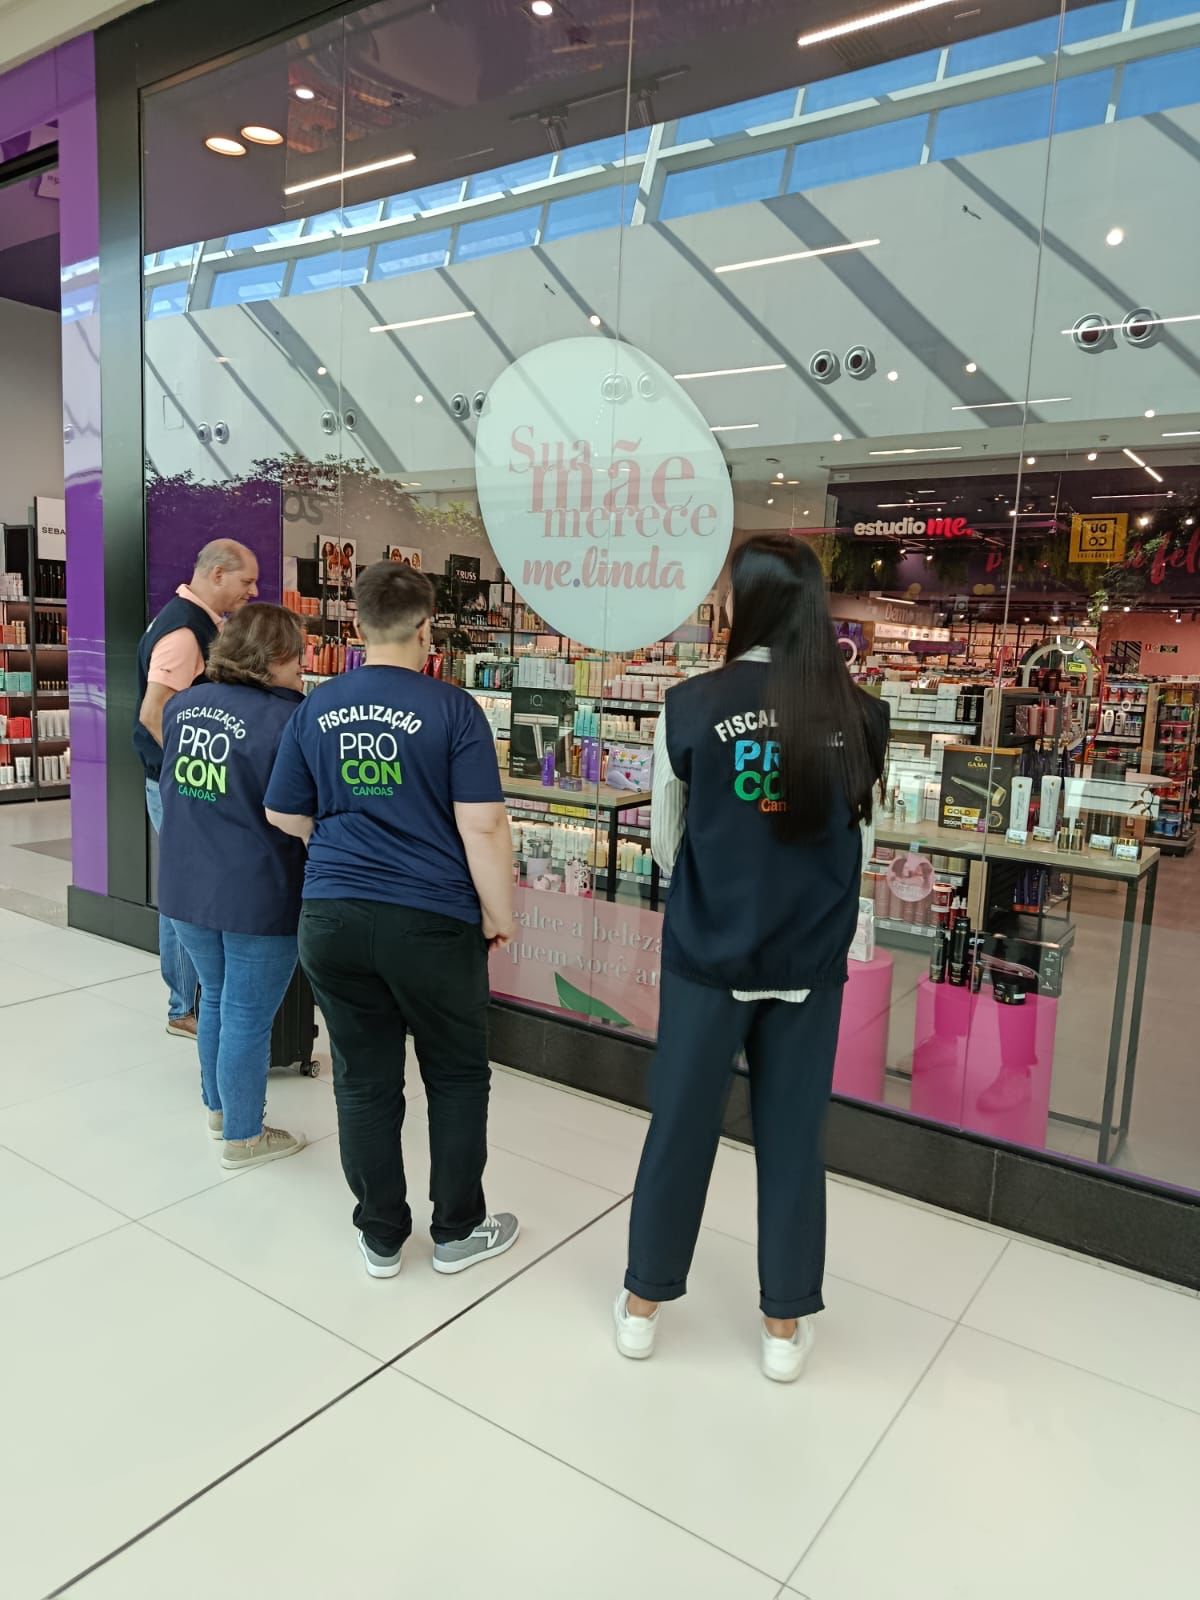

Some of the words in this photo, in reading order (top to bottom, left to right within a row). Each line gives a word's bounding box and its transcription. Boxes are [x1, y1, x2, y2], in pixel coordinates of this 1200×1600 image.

[509, 424, 591, 473] Sua
[528, 437, 696, 513] mãe
[41, 526, 66, 535] SEBA
[541, 503, 718, 538] merece
[853, 517, 926, 536] estudio
[455, 569, 477, 581] TRUSS
[176, 706, 246, 740] FISCALIZAÇÃO
[317, 704, 422, 734] FISCALIZAÇÃO
[714, 709, 779, 742] FISCAL
[178, 724, 230, 764] PRO
[339, 732, 398, 762] PRO
[735, 740, 781, 771] PR
[175, 755, 226, 794] CON
[341, 760, 402, 785] CON
[734, 770, 781, 801] CO
[178, 784, 217, 802] CANOAS
[352, 786, 394, 796] CANOAS
[760, 798, 787, 812] Can
[947, 808, 971, 817] GOLD
[512, 906, 564, 932] alce
[572, 922, 584, 938] a
[506, 941, 567, 966] quem
